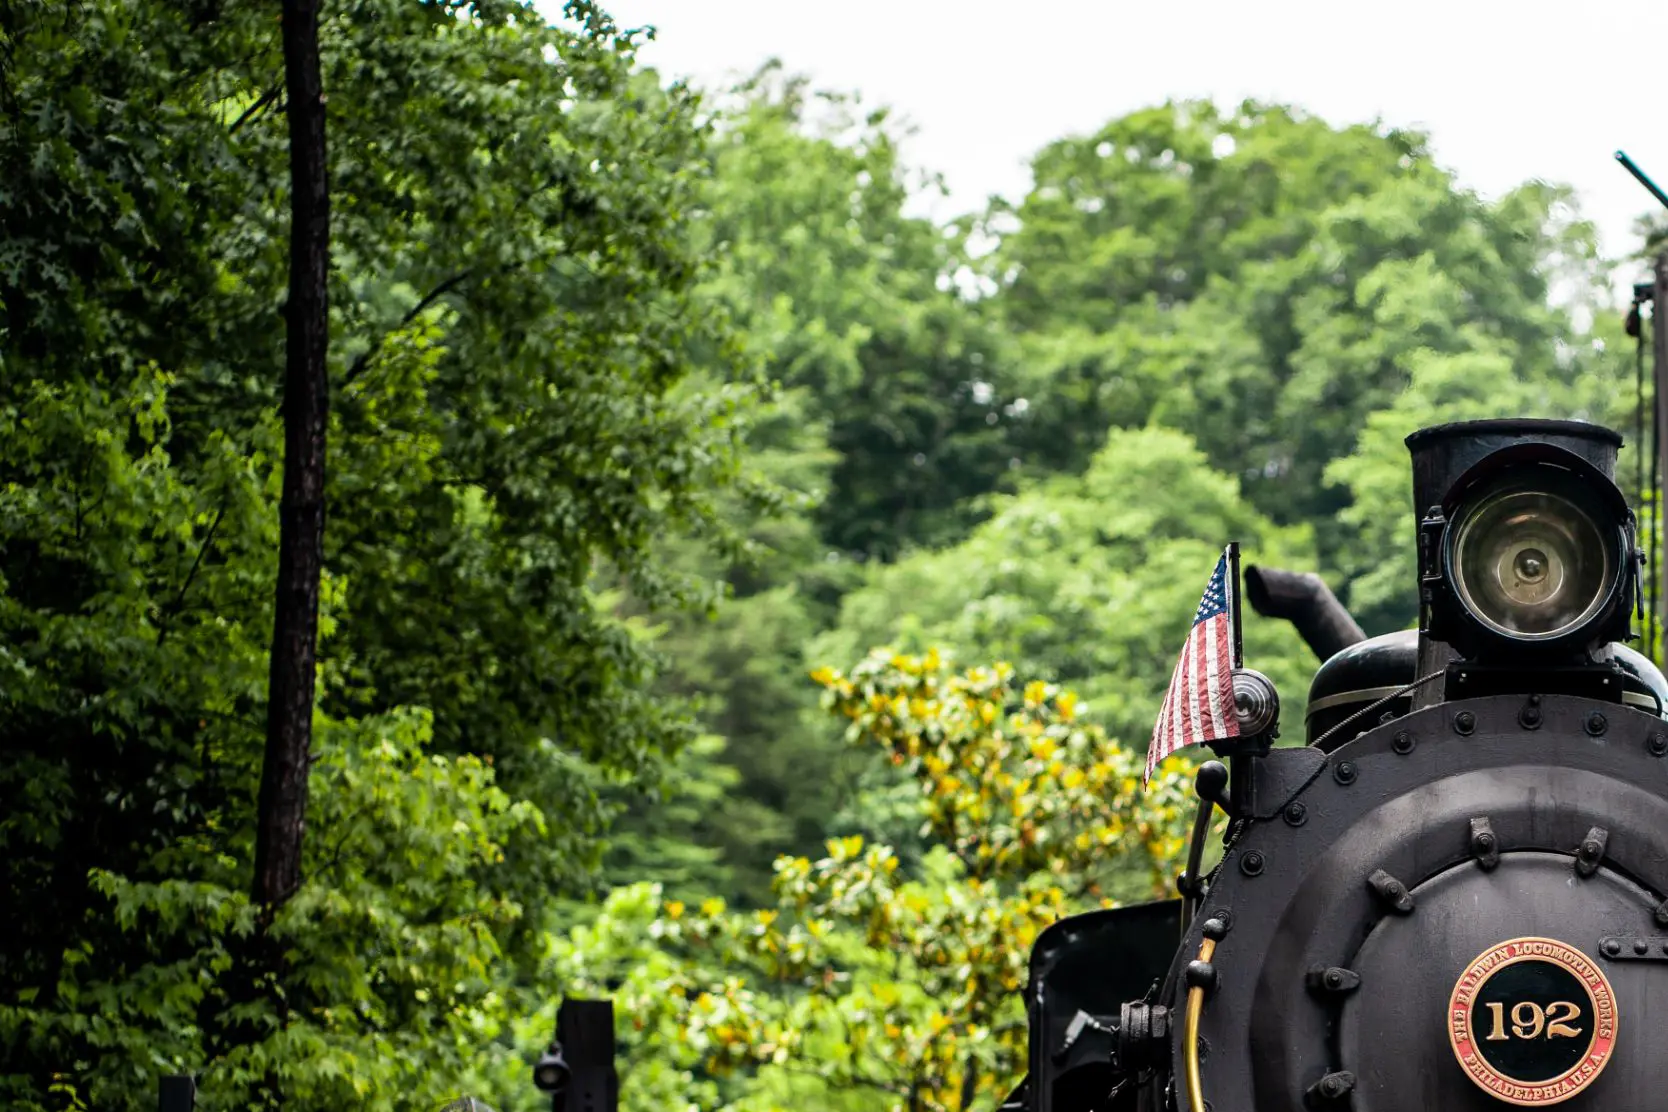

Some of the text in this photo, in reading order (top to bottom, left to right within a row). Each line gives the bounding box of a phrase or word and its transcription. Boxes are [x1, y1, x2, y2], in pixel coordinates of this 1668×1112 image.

[1453, 943, 1613, 1044] THE BALDWIN LOCOMOTIVE WORKS
[1485, 1001, 1583, 1041] 192
